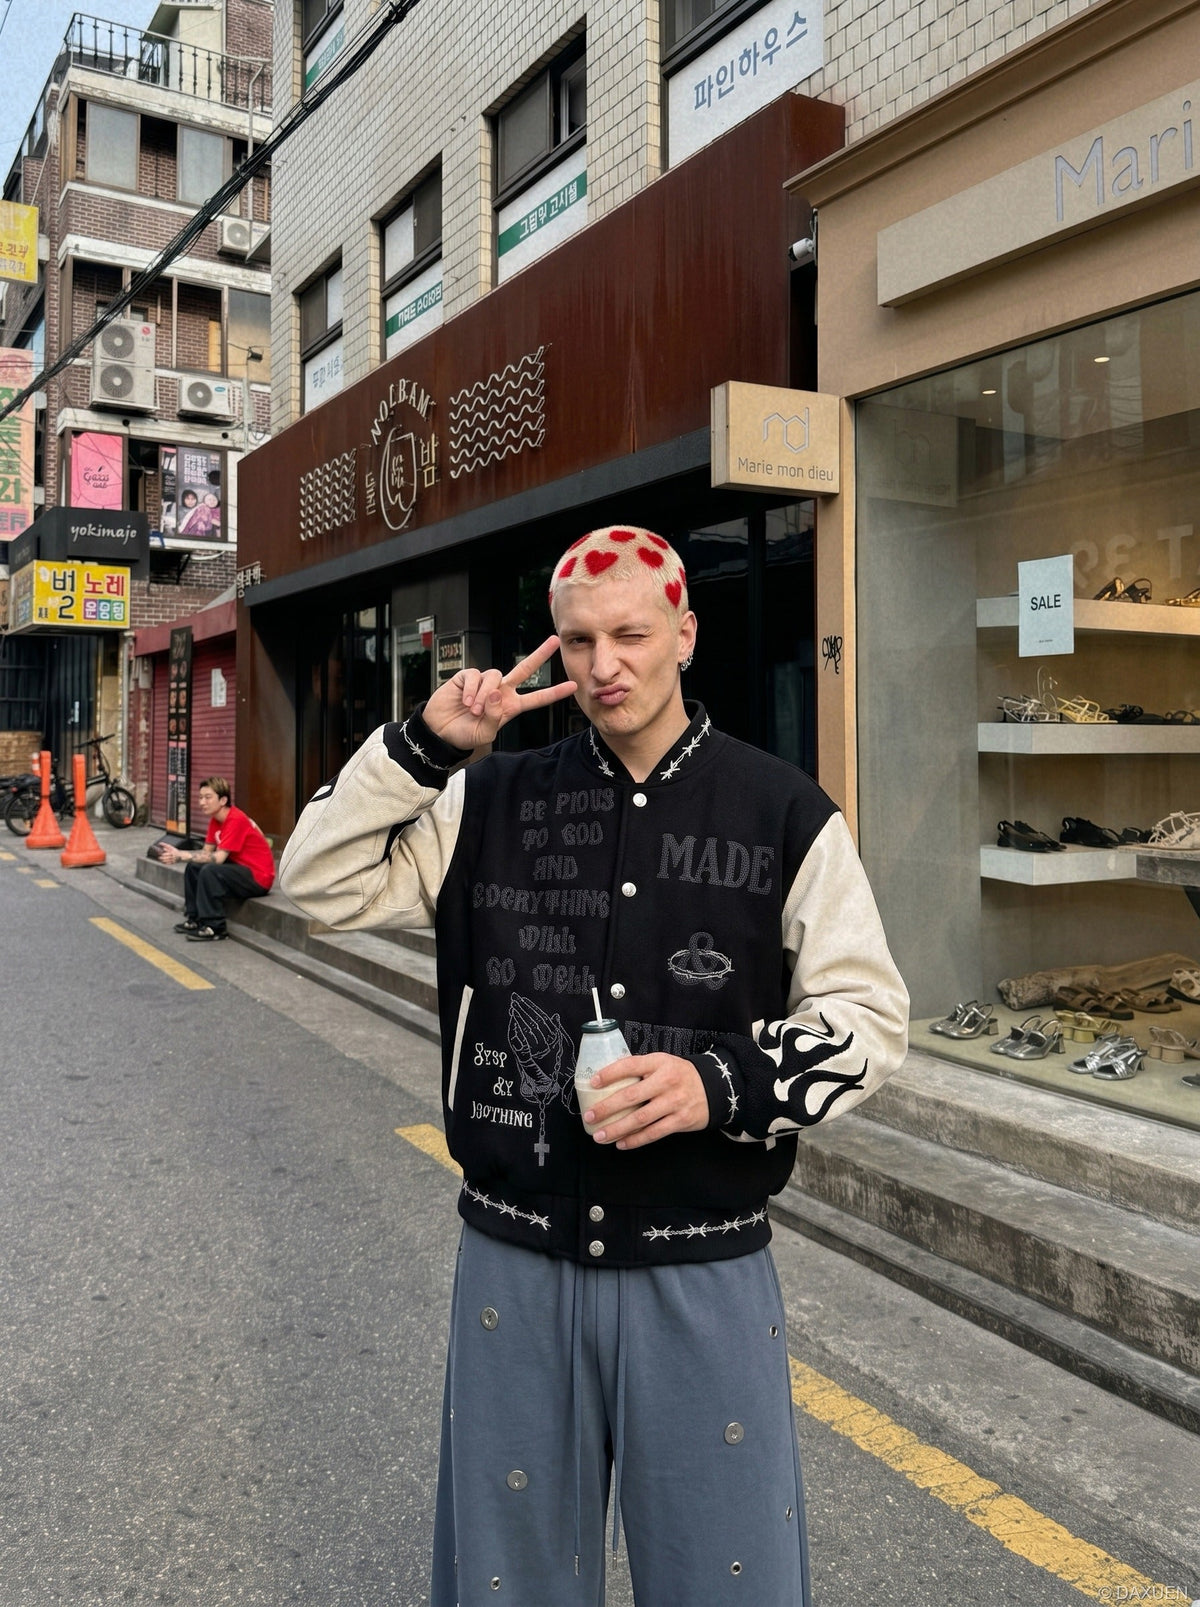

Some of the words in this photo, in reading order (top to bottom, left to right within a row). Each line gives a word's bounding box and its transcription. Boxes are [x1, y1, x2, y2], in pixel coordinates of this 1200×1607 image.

[694, 10, 808, 111] 파인하우스
[1055, 100, 1193, 222] Mari
[371, 378, 430, 446] NOLBAM
[738, 457, 773, 475] Marie
[777, 464, 804, 478] mon
[808, 466, 834, 481] dieu
[84, 572, 125, 597] 노래
[58, 595, 75, 619] 2
[1030, 594, 1061, 611] SALE
[554, 787, 615, 815] PIOUS
[533, 854, 578, 881] AND
[656, 832, 775, 896] MADE
